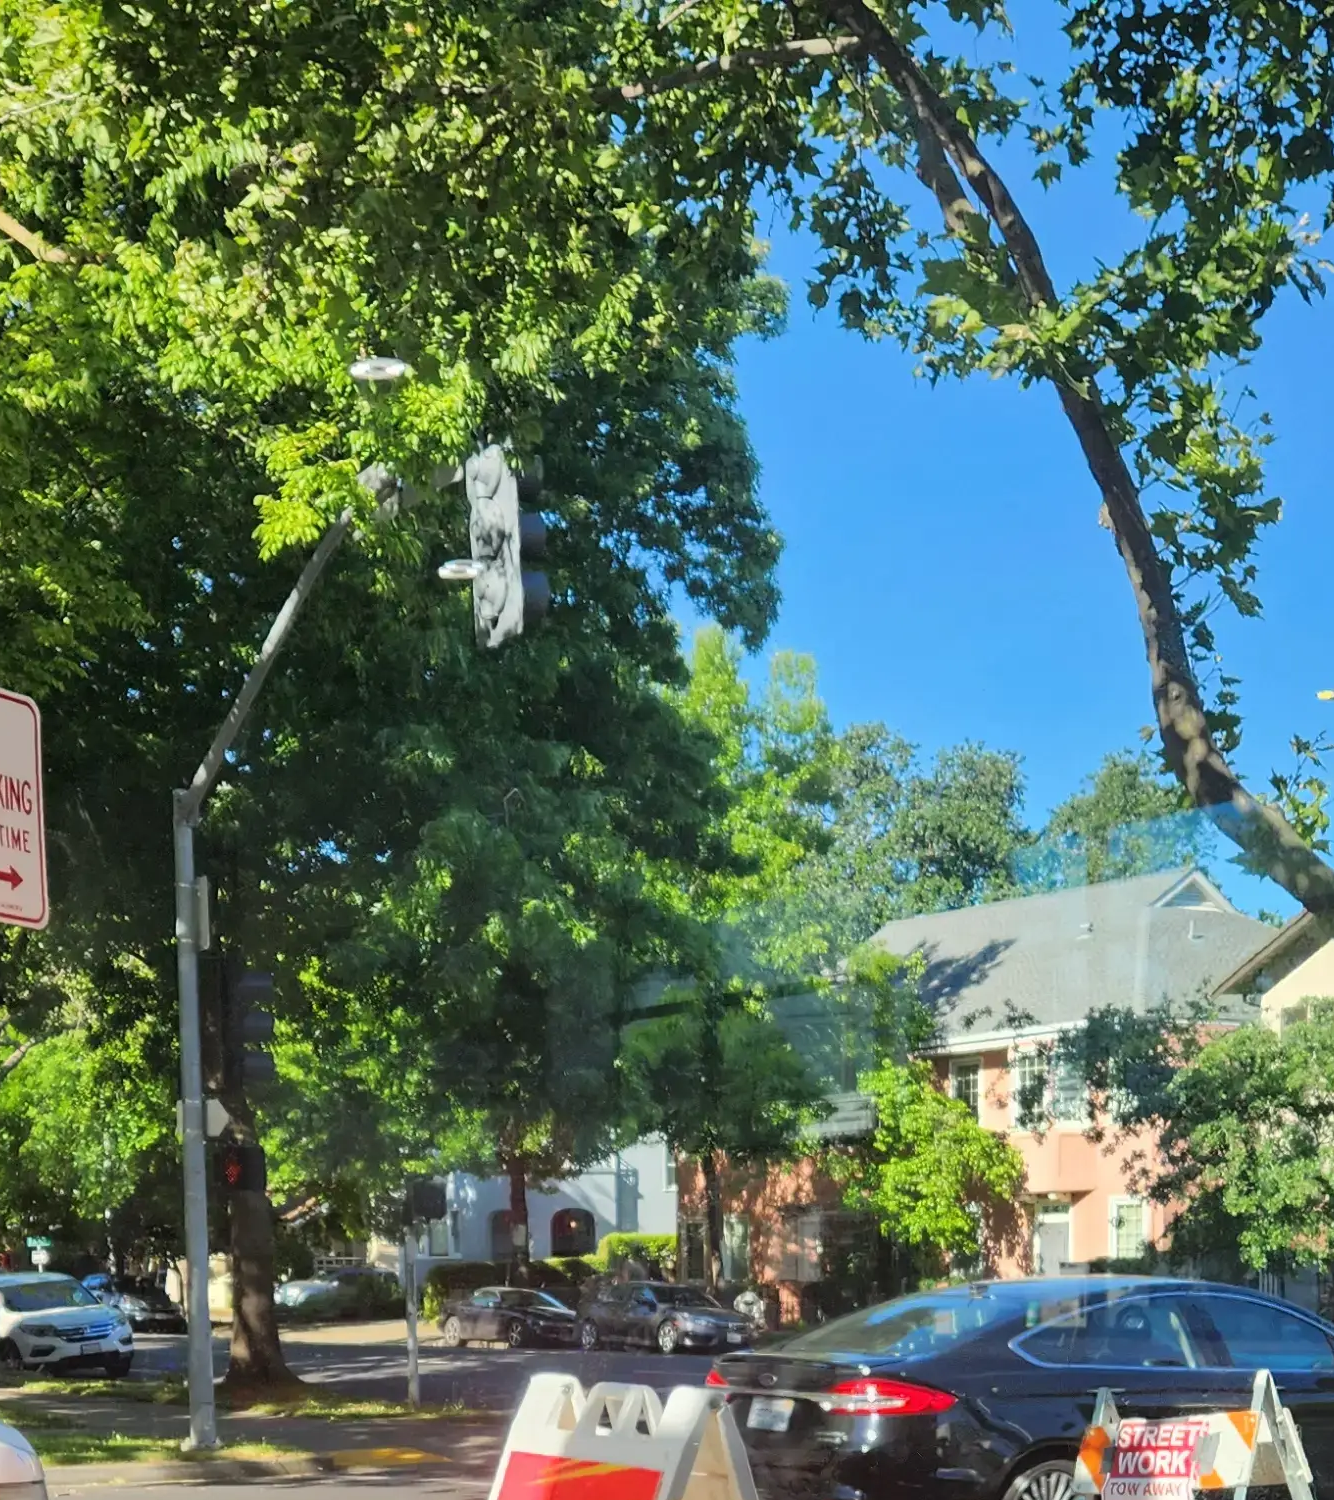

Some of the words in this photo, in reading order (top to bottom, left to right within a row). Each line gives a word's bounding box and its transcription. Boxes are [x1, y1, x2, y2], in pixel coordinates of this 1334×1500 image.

[1118, 1424, 1200, 1449] STREET
[1117, 1449, 1191, 1475] WORK
[1109, 1482, 1142, 1496] TOW
[1142, 1482, 1183, 1496] AWAY
